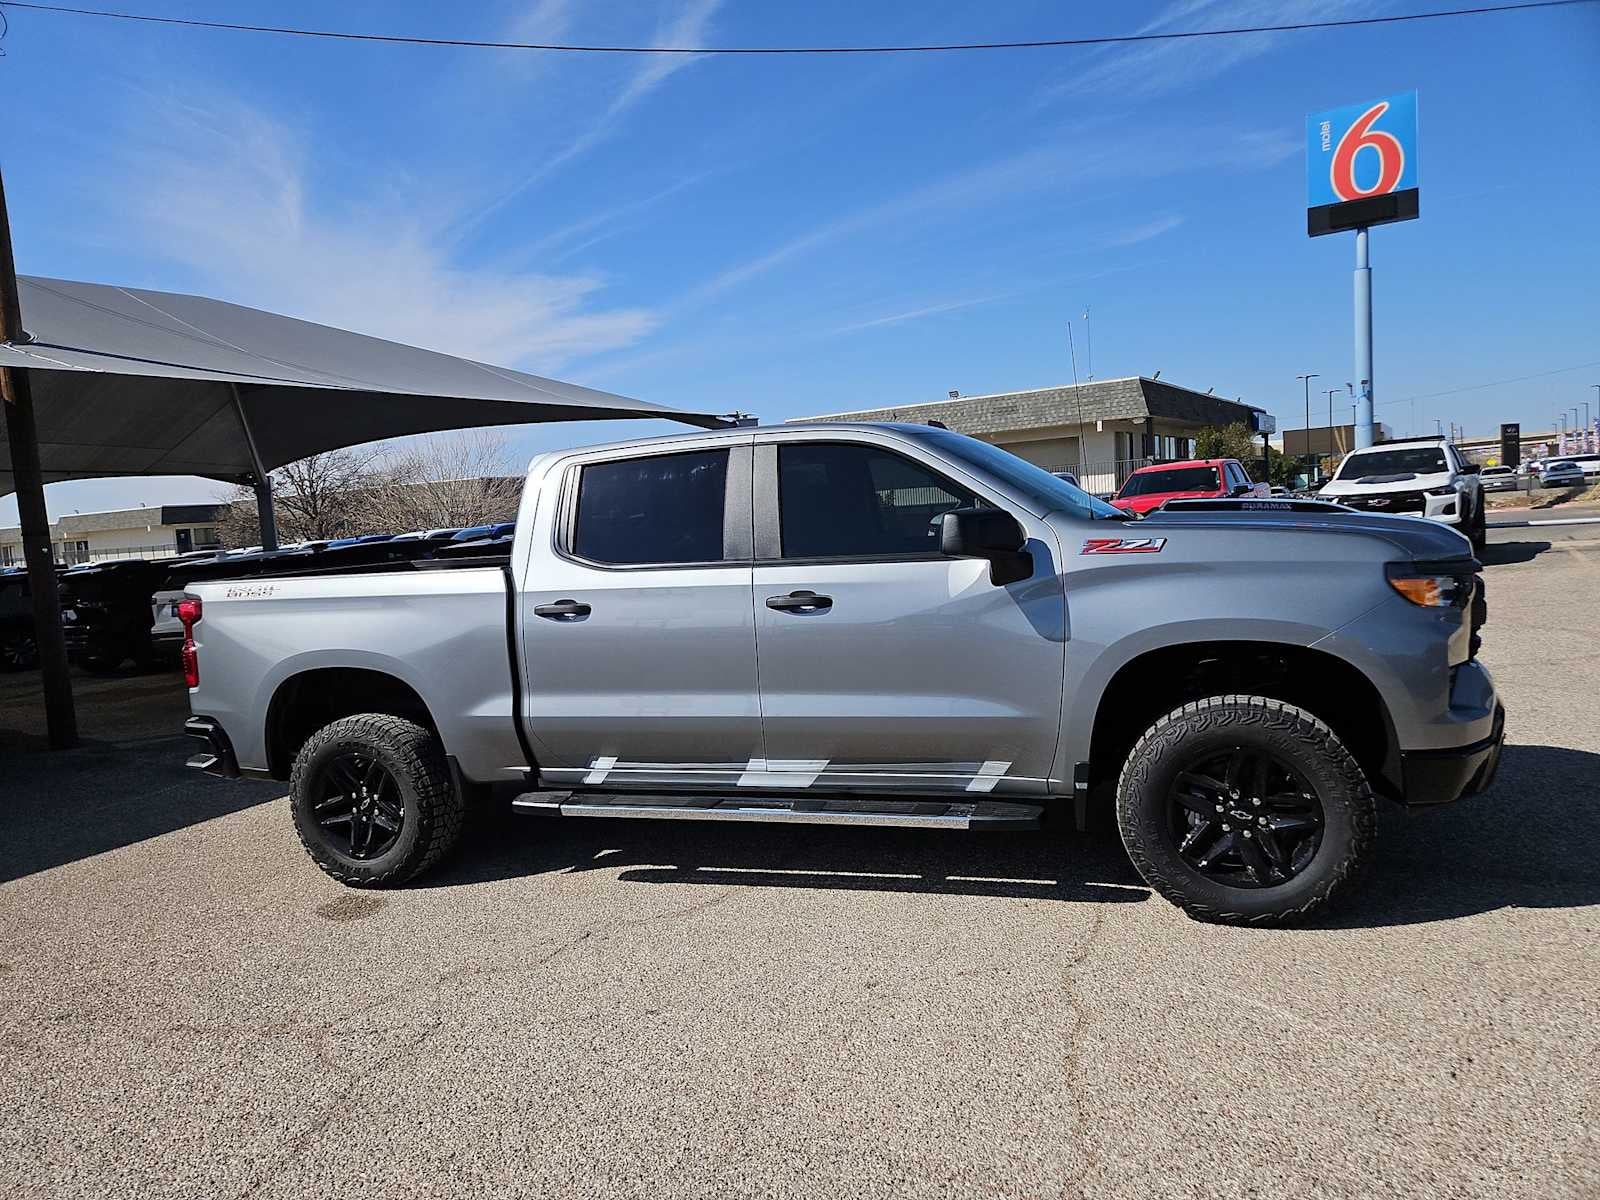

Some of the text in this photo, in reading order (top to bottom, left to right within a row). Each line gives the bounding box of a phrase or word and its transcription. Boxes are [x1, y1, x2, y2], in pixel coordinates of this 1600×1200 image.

[1330, 101, 1405, 202] 6
[1240, 502, 1293, 511] DURAMAX
[1080, 537, 1167, 555] Z71
